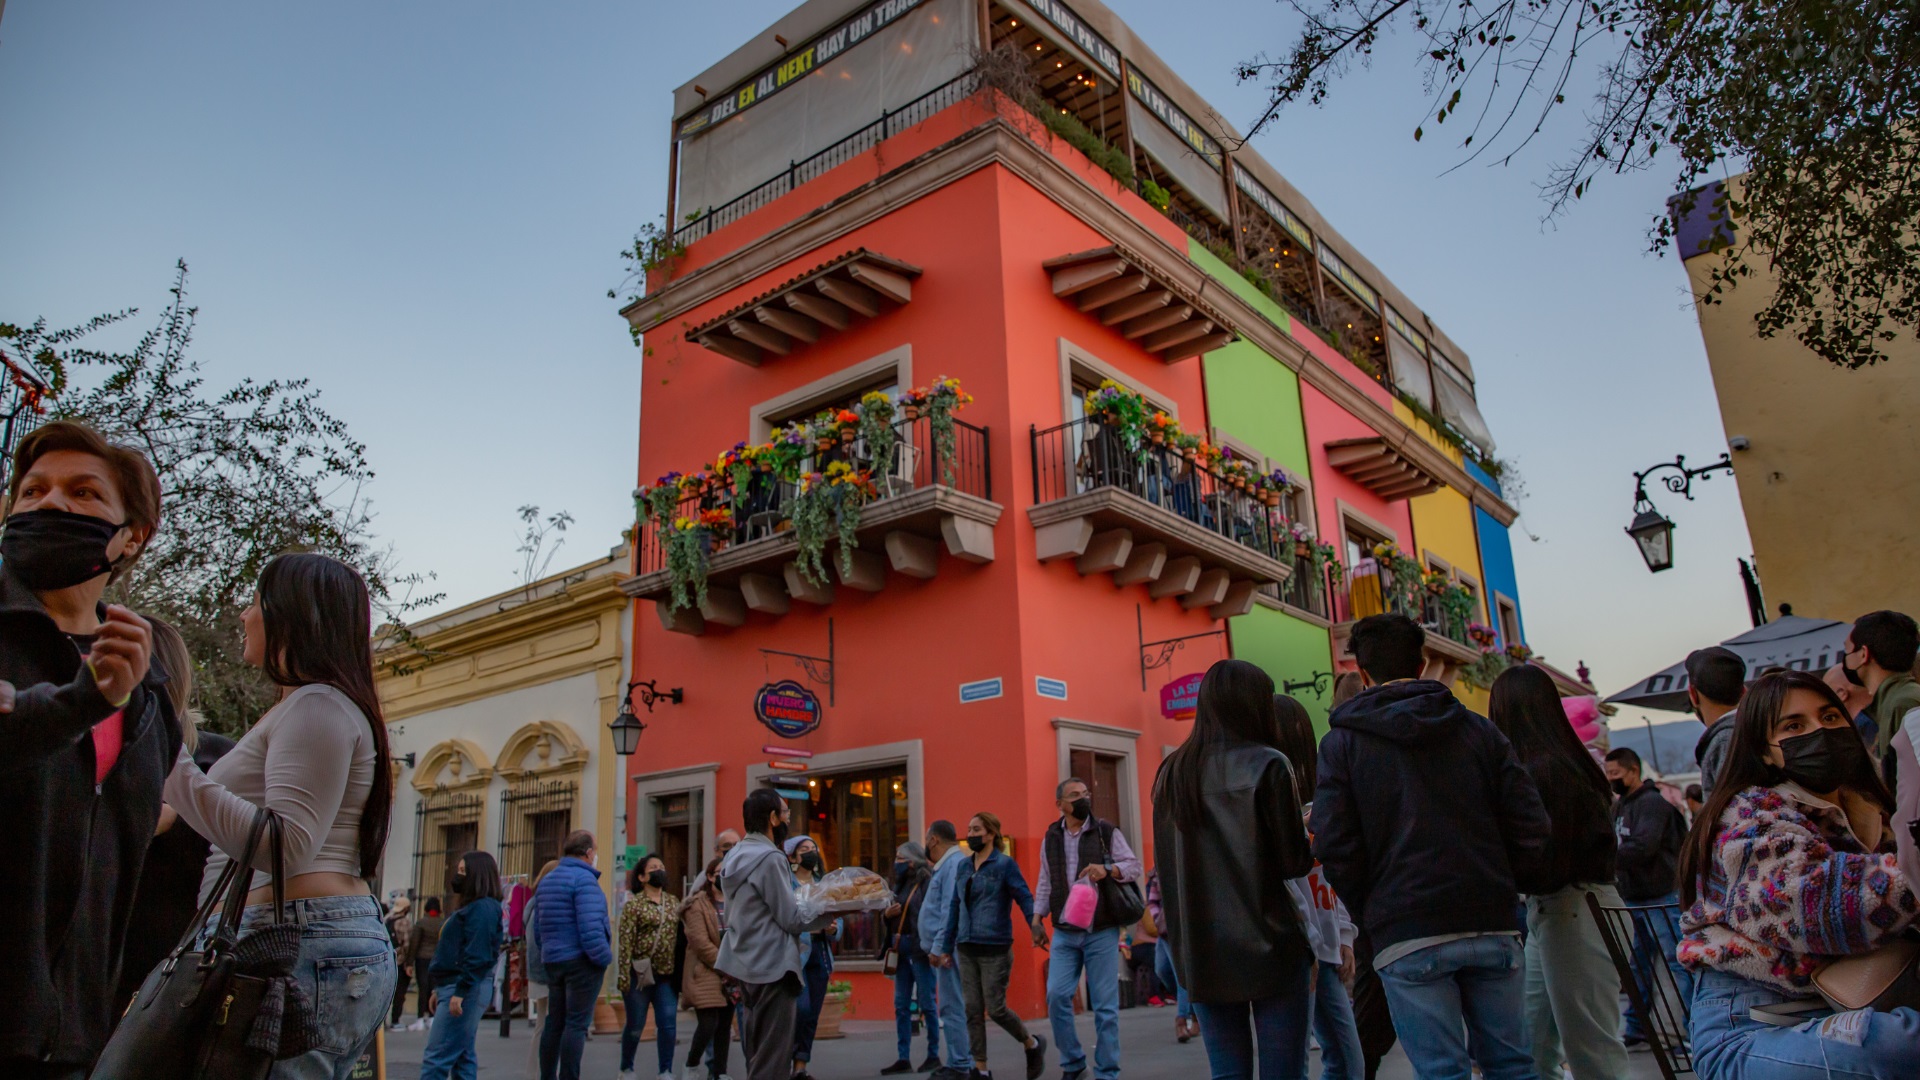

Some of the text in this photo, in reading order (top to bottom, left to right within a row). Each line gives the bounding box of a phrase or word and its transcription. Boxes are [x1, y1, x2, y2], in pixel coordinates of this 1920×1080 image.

[1052, 3, 1075, 36] HAY
[1098, 44, 1120, 75] LOS
[711, 95, 736, 123] DEL
[738, 83, 756, 109] EX
[757, 72, 775, 98] AL
[777, 47, 815, 87] NEXT
[817, 28, 846, 63] HAY
[850, 13, 873, 42] UN
[1143, 84, 1151, 103] Y
[1169, 108, 1187, 138] LOS
[767, 694, 805, 710] MUERO
[1172, 685, 1185, 698] LA
[766, 706, 813, 722] HAMBRE
